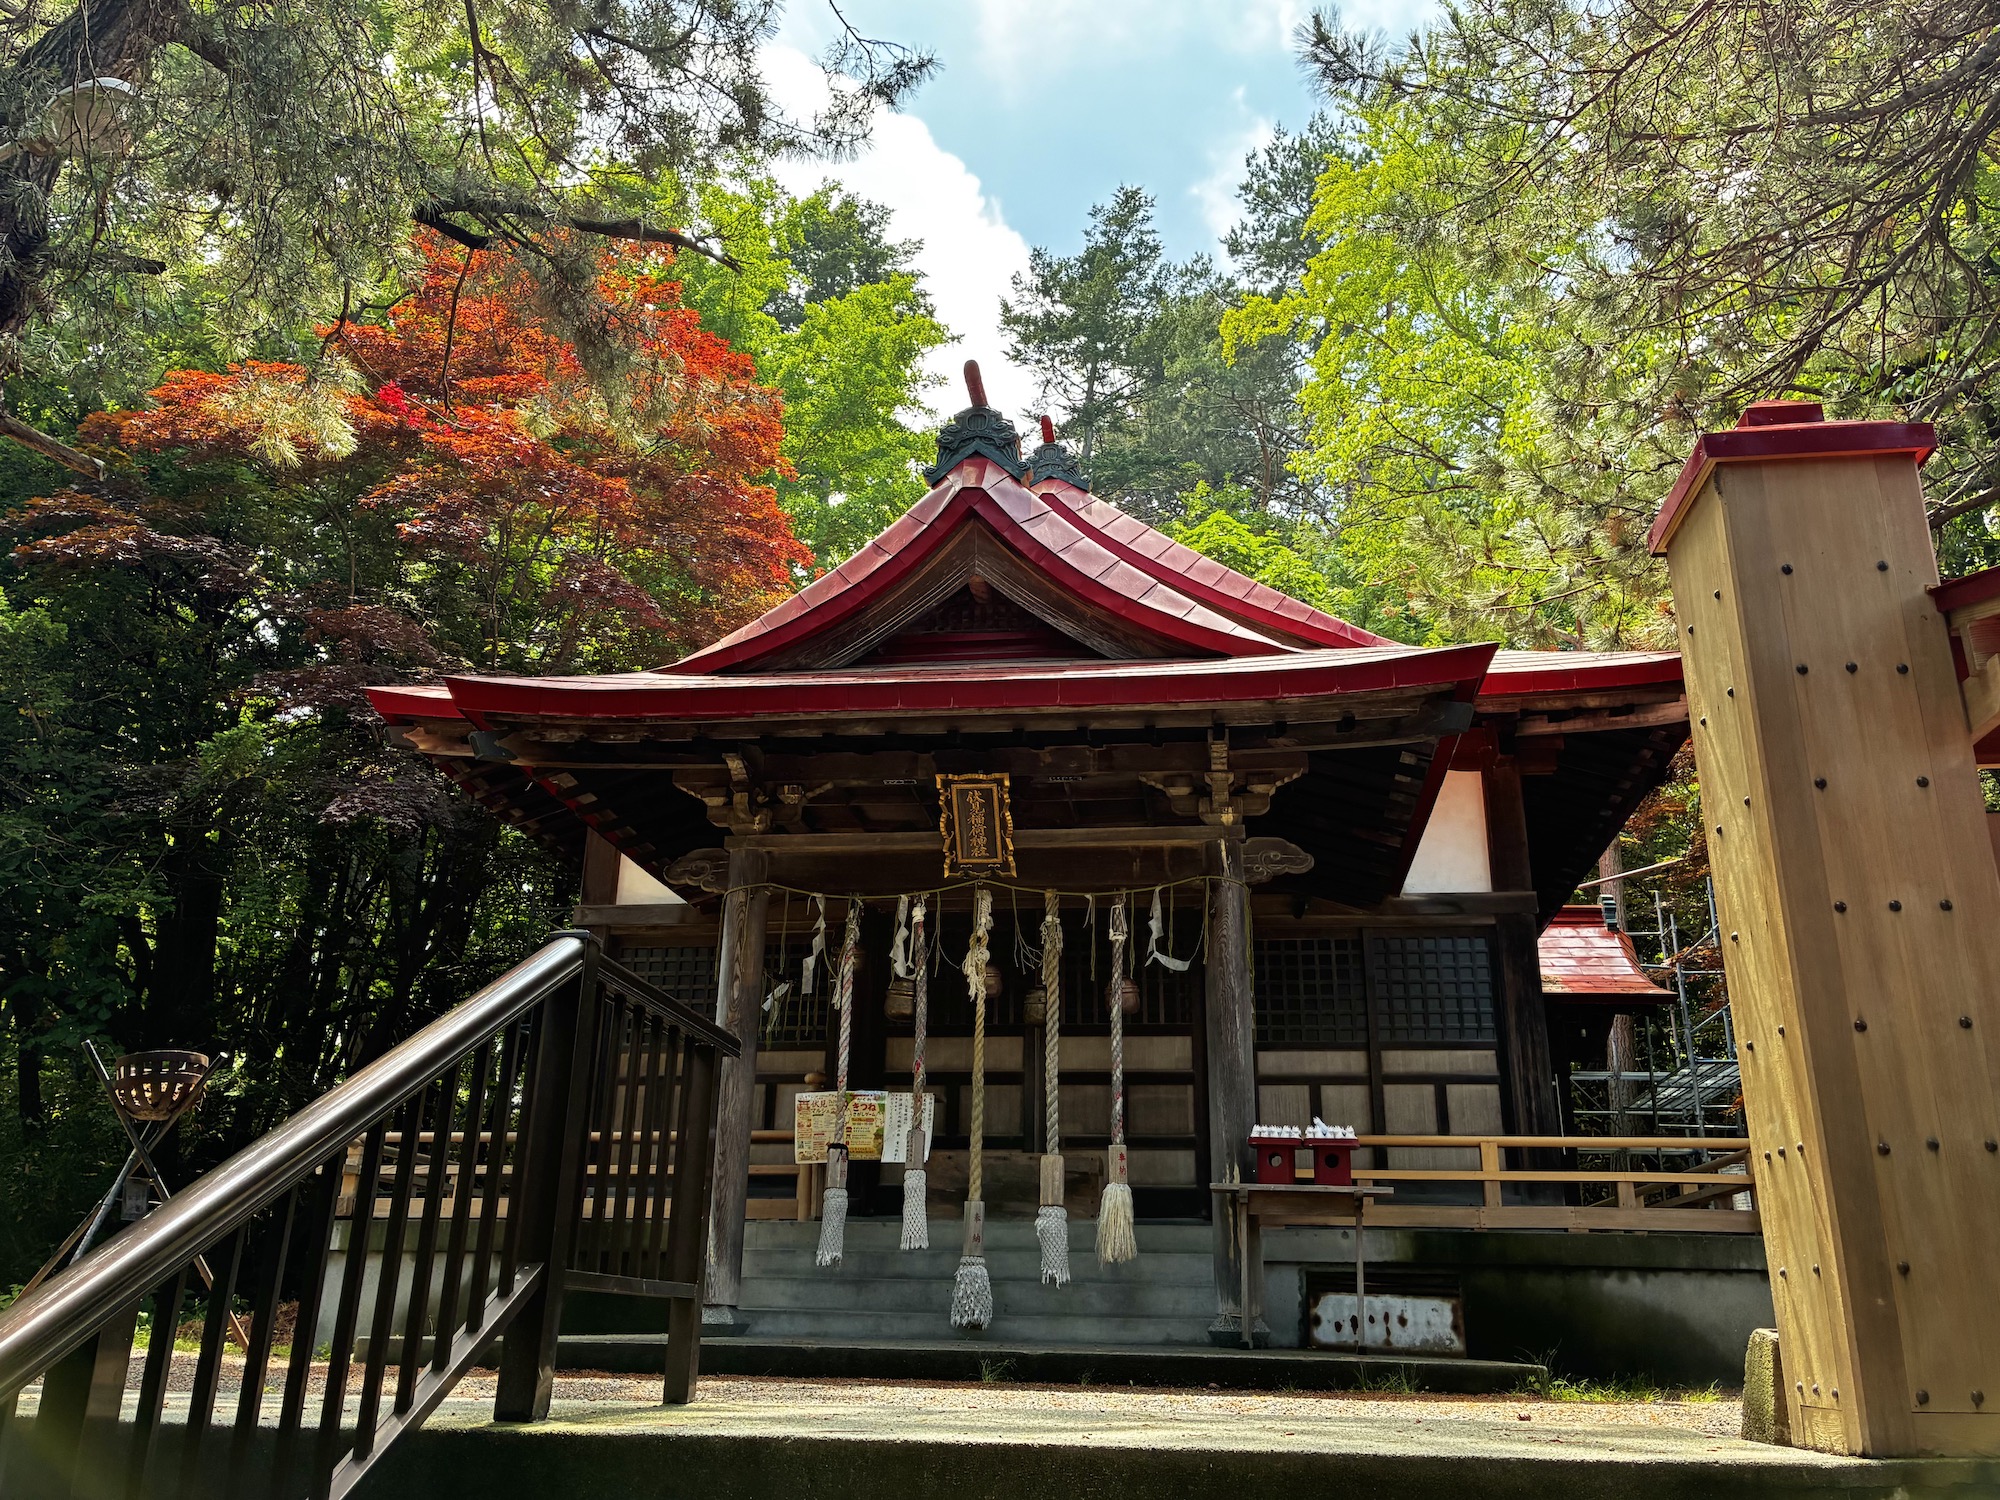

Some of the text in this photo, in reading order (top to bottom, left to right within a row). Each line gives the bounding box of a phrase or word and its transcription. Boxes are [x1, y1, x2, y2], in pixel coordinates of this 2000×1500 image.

[966, 789, 989, 858] 伏見稲荷神社
[811, 1100, 828, 1108] 伏見
[852, 1103, 877, 1112] きつね
[1118, 1152, 1126, 1175] 奉納
[972, 1213, 981, 1244] 奉納
